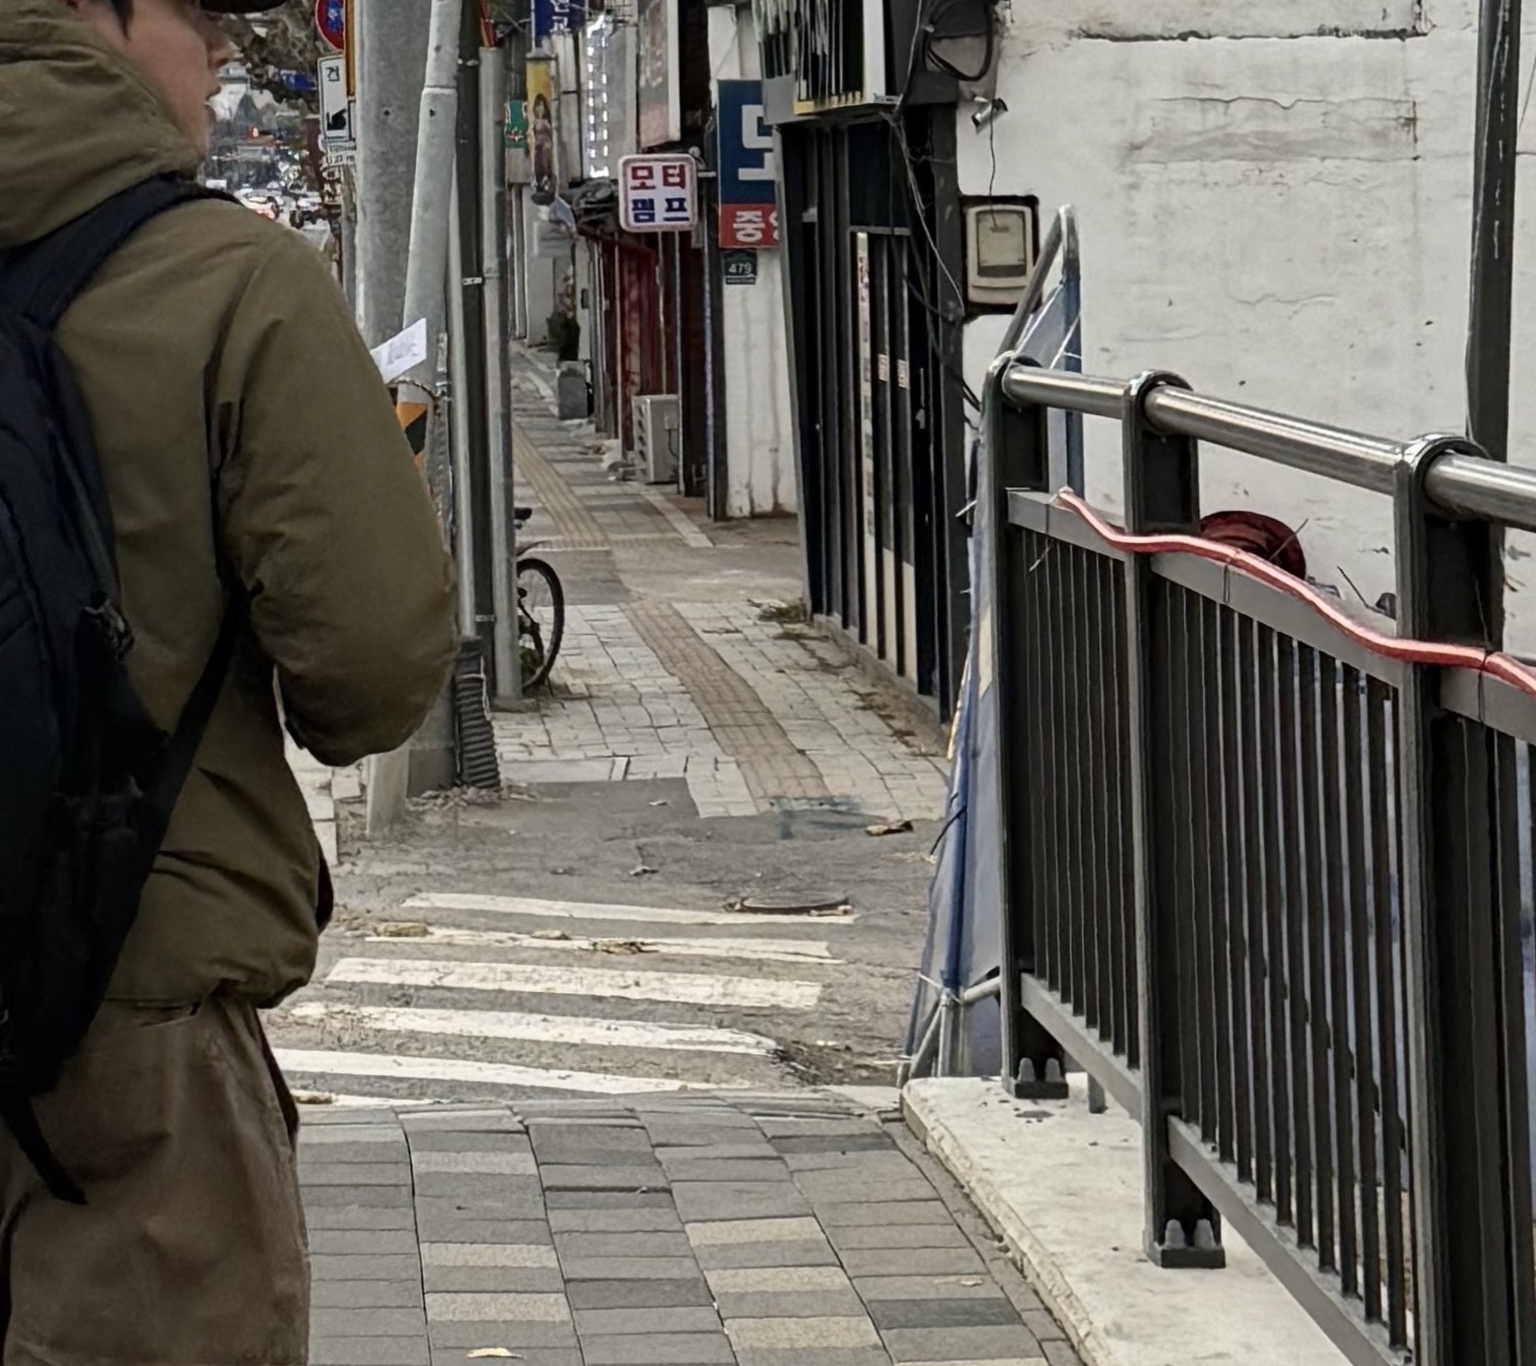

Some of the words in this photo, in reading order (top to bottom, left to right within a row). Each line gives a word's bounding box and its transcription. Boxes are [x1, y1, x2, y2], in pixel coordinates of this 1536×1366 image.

[630, 163, 686, 190] 모터
[631, 197, 691, 224] 펌프
[728, 261, 753, 275] 479
